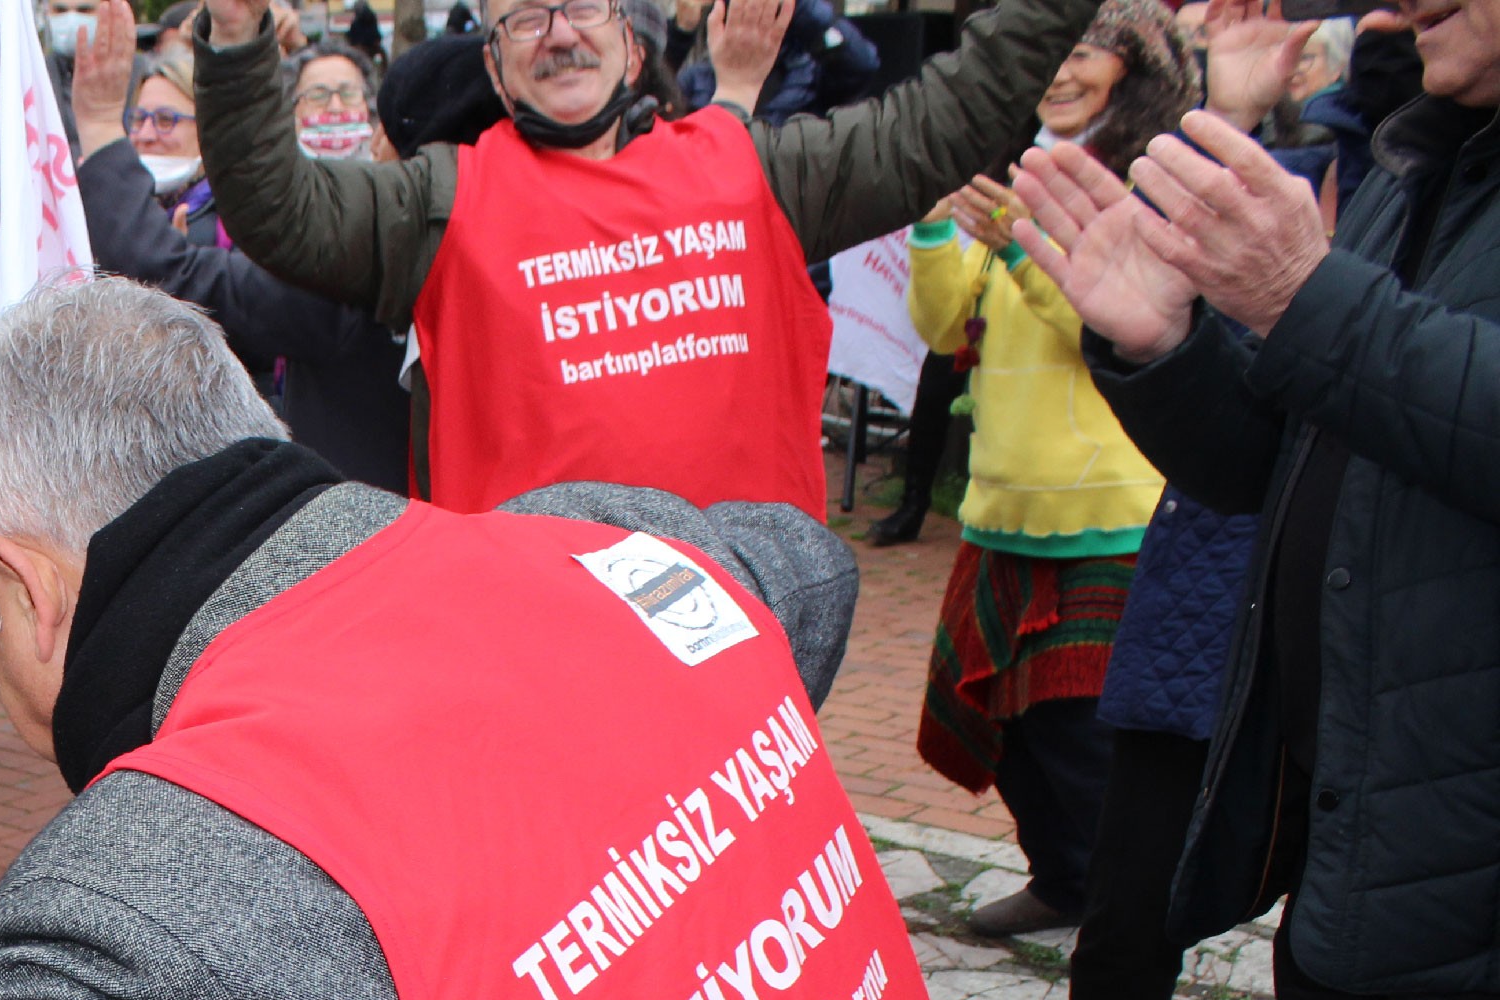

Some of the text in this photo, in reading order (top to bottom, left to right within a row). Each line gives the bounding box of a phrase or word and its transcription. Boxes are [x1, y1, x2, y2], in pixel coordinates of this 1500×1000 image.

[518, 220, 747, 288] TERMİKSİZ YAŞAM
[541, 274, 746, 342] İSTİYORUM
[560, 333, 749, 384] bartınplatformu
[710, 695, 818, 821] YAŞAM
